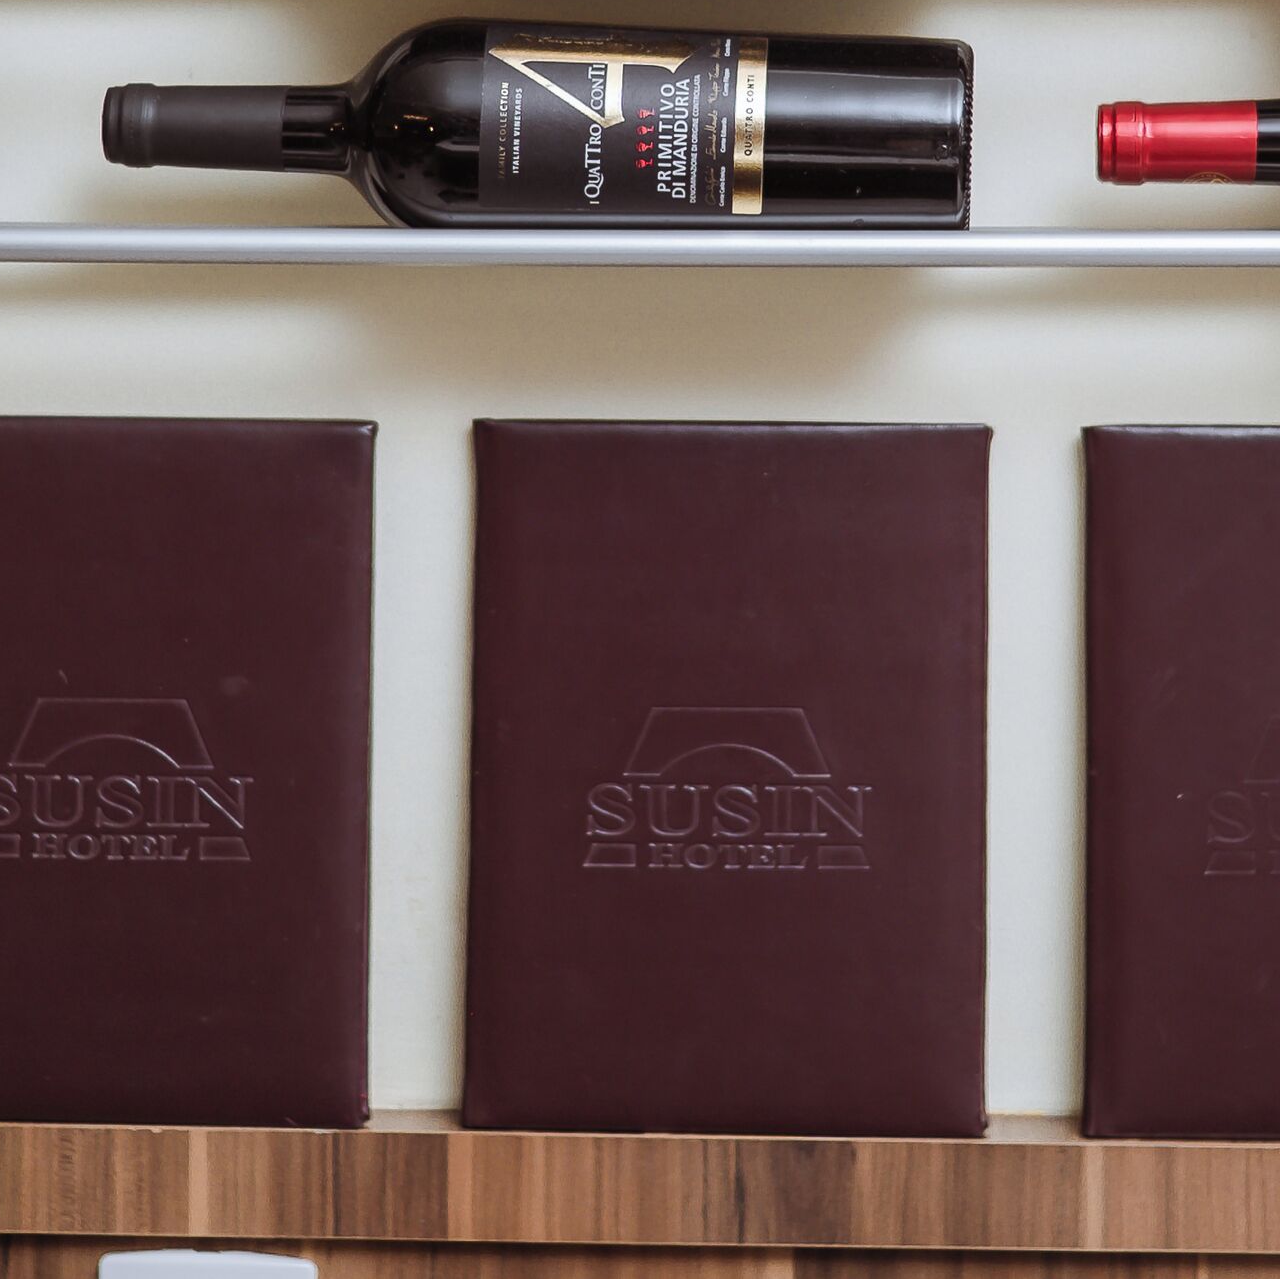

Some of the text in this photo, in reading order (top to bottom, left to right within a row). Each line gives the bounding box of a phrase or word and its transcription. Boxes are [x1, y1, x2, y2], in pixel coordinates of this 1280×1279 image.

[498, 81, 510, 180] FAMILY COLLECTION
[512, 87, 523, 174] ITALIAN VINEYARDS
[656, 83, 675, 193] PRIMITIVO
[672, 77, 691, 199] DI MANDURIA
[691, 117, 700, 144] ORIGINE
[743, 73, 755, 158] QUATTRO CONTI
[691, 143, 699, 152] DI
[690, 151, 699, 204] DENOMINAZIONE
[586, 782, 872, 838] SUSIN
[32, 832, 191, 860] HOTEL
[648, 842, 808, 870] HOTEL
